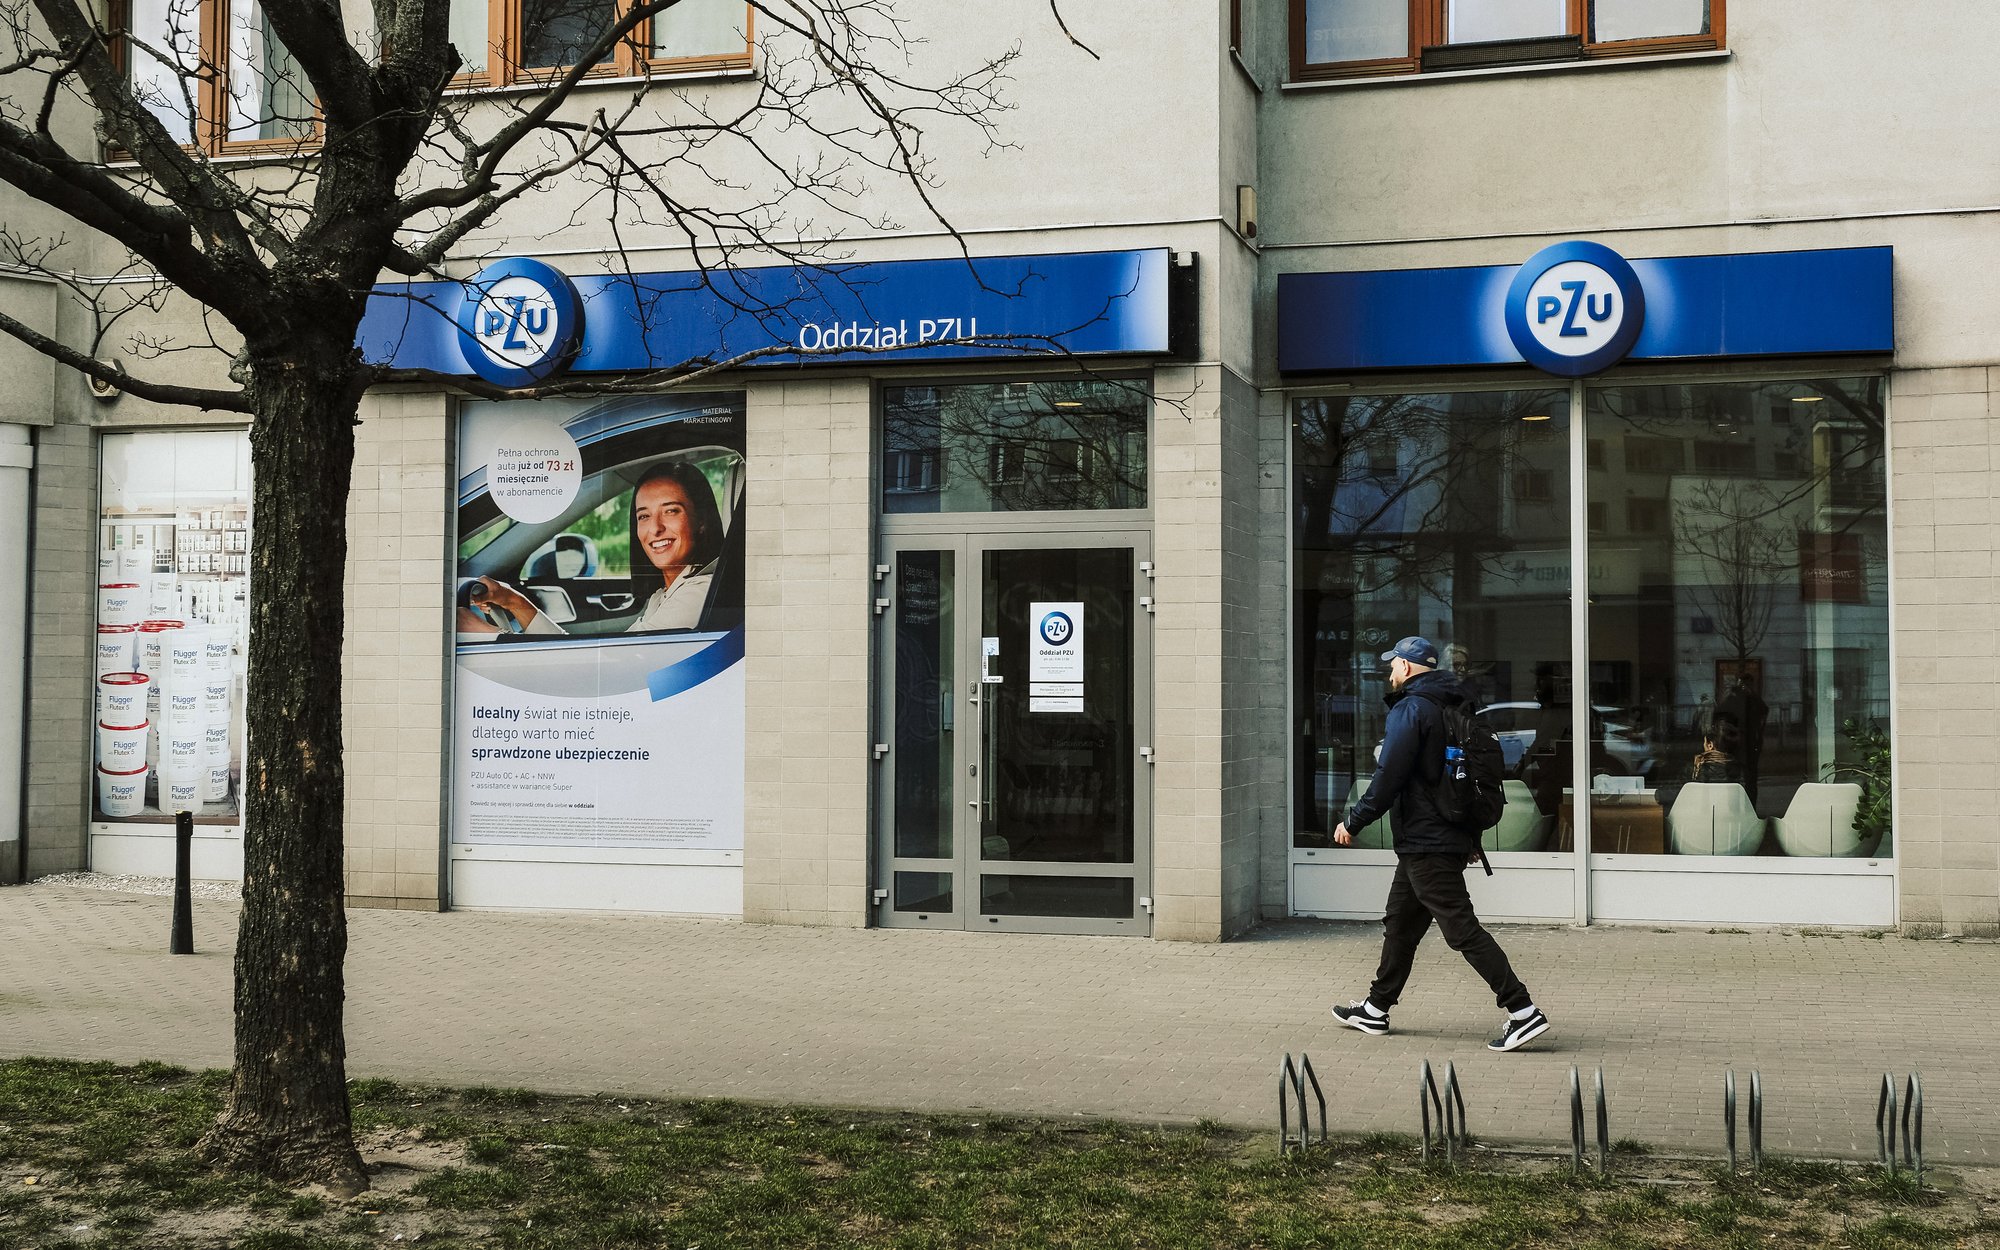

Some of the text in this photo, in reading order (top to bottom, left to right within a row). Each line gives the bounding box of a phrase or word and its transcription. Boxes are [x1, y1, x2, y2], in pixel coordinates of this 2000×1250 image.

[1537, 281, 1612, 337] PZU
[484, 295, 549, 350] PZU
[799, 317, 977, 350] Oddział PZU
[702, 407, 733, 415] MATERIAŁ
[683, 416, 733, 425] MARKETINGOWY
[497, 448, 559, 457] Pełna ochrona
[497, 459, 575, 473] auta już od 73 zł
[497, 473, 549, 485] miesięcznie
[497, 486, 563, 497] w abonamencie
[1047, 621, 1066, 636] PZU
[173, 649, 198, 658] Flügger
[109, 695, 133, 704] Flügger
[172, 695, 197, 704] Flügger
[472, 705, 635, 723] Idealny świat nie istnieje,
[472, 725, 596, 742] dlatego warto mieć
[113, 741, 138, 750] Flügger
[172, 740, 197, 750] Flügger
[471, 747, 650, 763] sprawdzone ubezpieczenie
[471, 771, 485, 780] PZU
[486, 771, 502, 780] Auto
[502, 772, 513, 780] OC
[520, 772, 530, 780] AC
[537, 772, 556, 780] NNW
[111, 786, 136, 795] Flügger
[171, 785, 196, 794] Flügger
[476, 782, 511, 791] assistance
[520, 782, 551, 791] wariancie
[553, 783, 573, 793] Super
